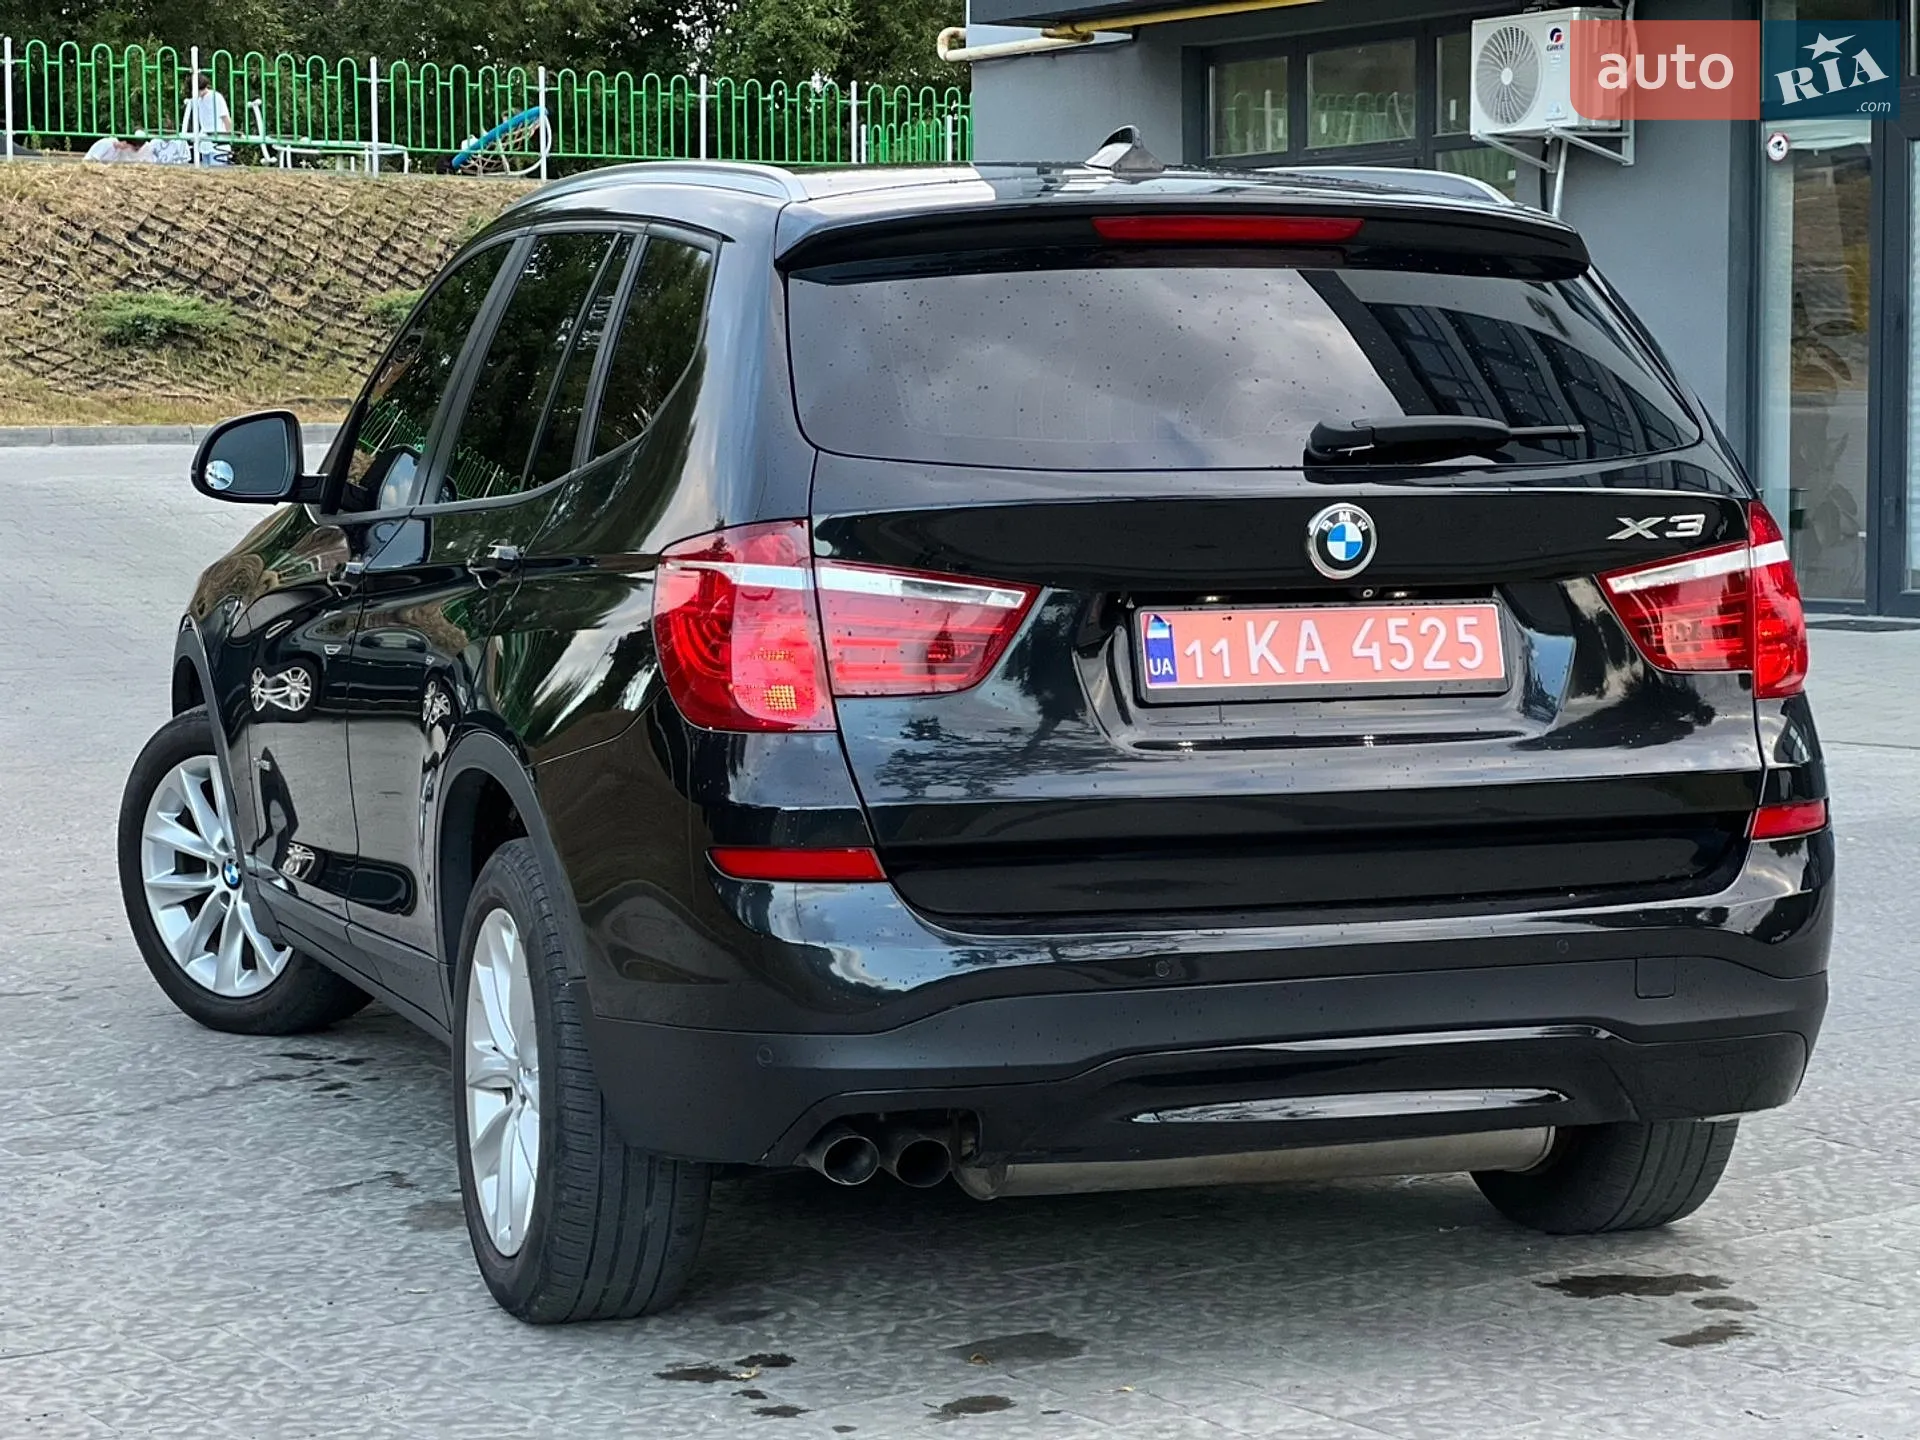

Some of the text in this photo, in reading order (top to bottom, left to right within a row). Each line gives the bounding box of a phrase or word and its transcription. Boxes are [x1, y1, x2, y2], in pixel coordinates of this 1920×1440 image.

[1320, 511, 1368, 532] BMW
[1607, 513, 1706, 540] X3
[1184, 616, 1484, 678] 11 KA 4525
[1149, 658, 1174, 676] UA
